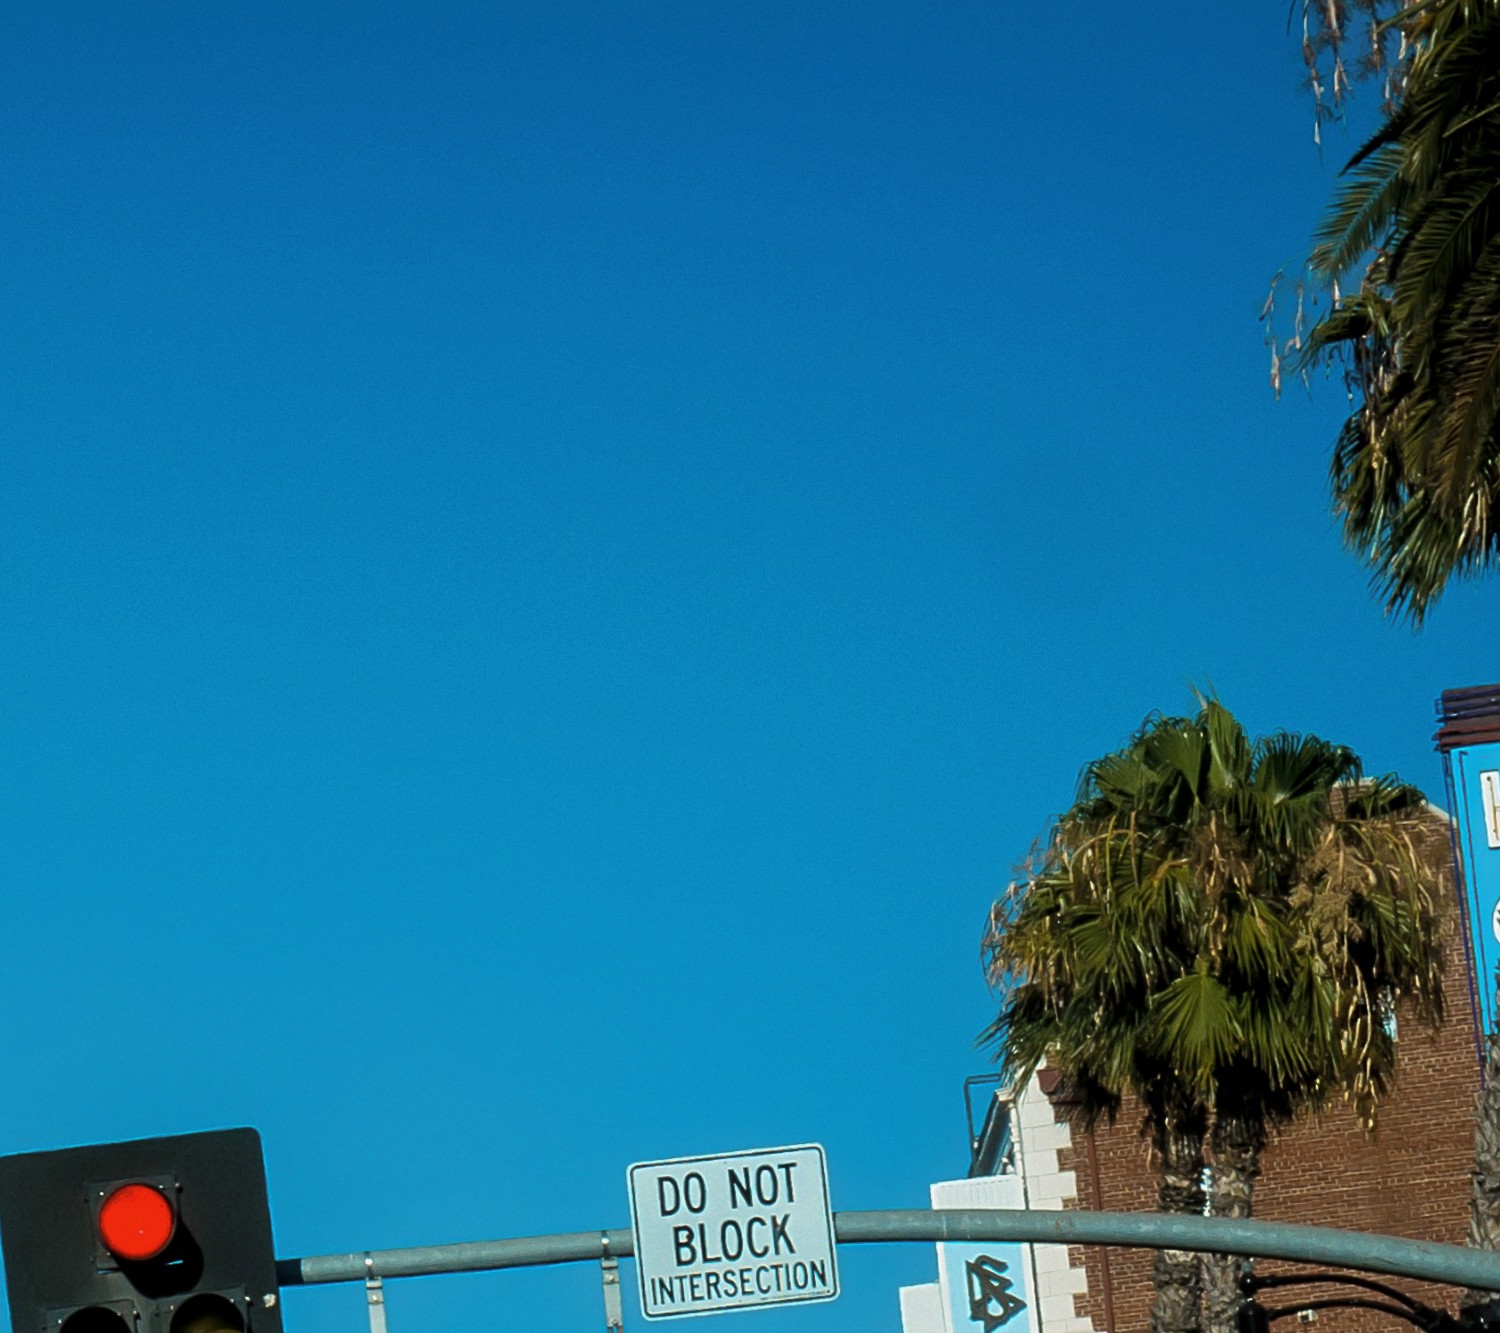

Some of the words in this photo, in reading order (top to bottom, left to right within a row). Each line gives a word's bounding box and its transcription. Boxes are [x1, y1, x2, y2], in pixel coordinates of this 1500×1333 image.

[656, 1172, 706, 1217] DO
[727, 1162, 798, 1209] NOT
[673, 1213, 797, 1267] BLOCK
[650, 1258, 828, 1306] INTERSECTION
